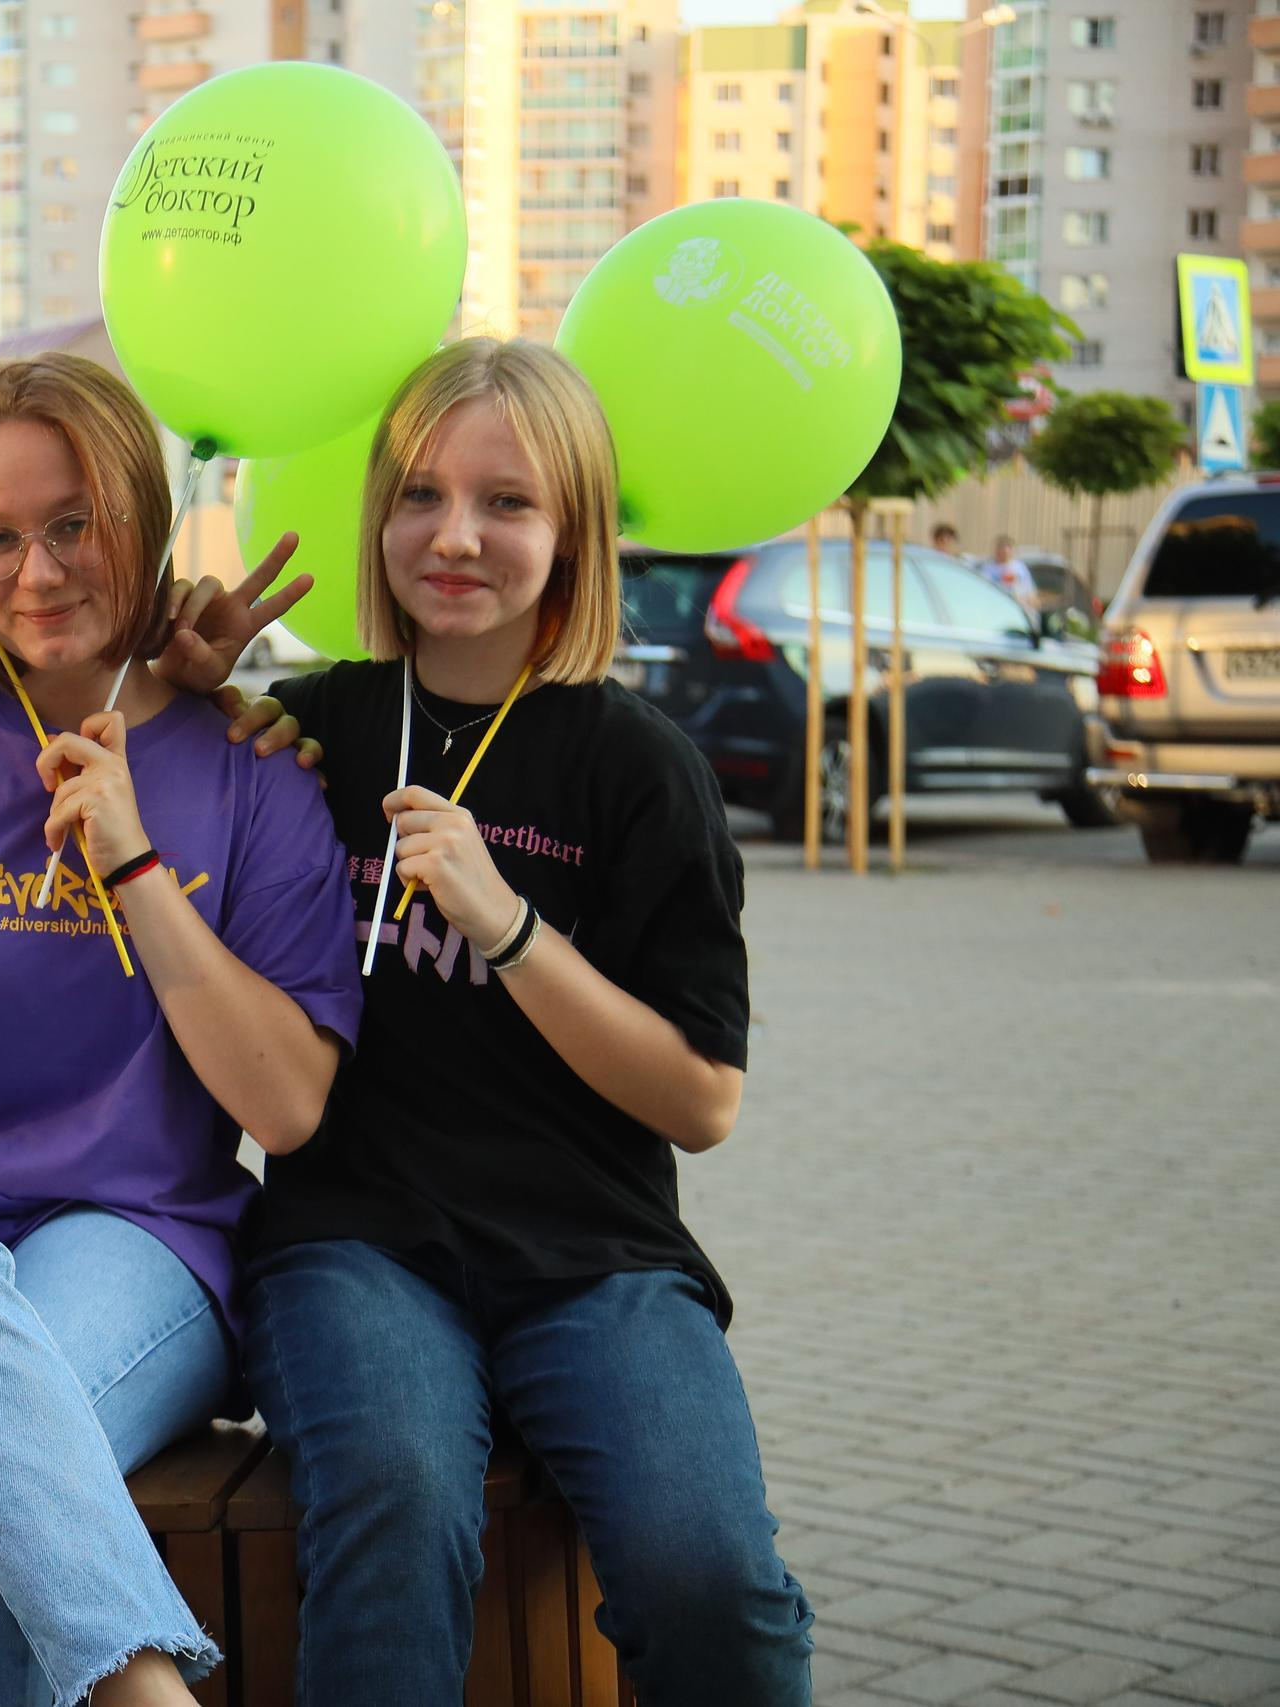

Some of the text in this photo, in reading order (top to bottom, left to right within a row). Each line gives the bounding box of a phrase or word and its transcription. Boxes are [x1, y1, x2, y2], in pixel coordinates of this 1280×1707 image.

[111, 140, 268, 209] Детский
[145, 180, 256, 228] доктор
[141, 226, 242, 246] www.детдоктор.рф
[741, 289, 831, 368] ДОКТОР
[754, 271, 852, 368] ДЕТСКИЙ
[474, 817, 584, 867] eetheart
